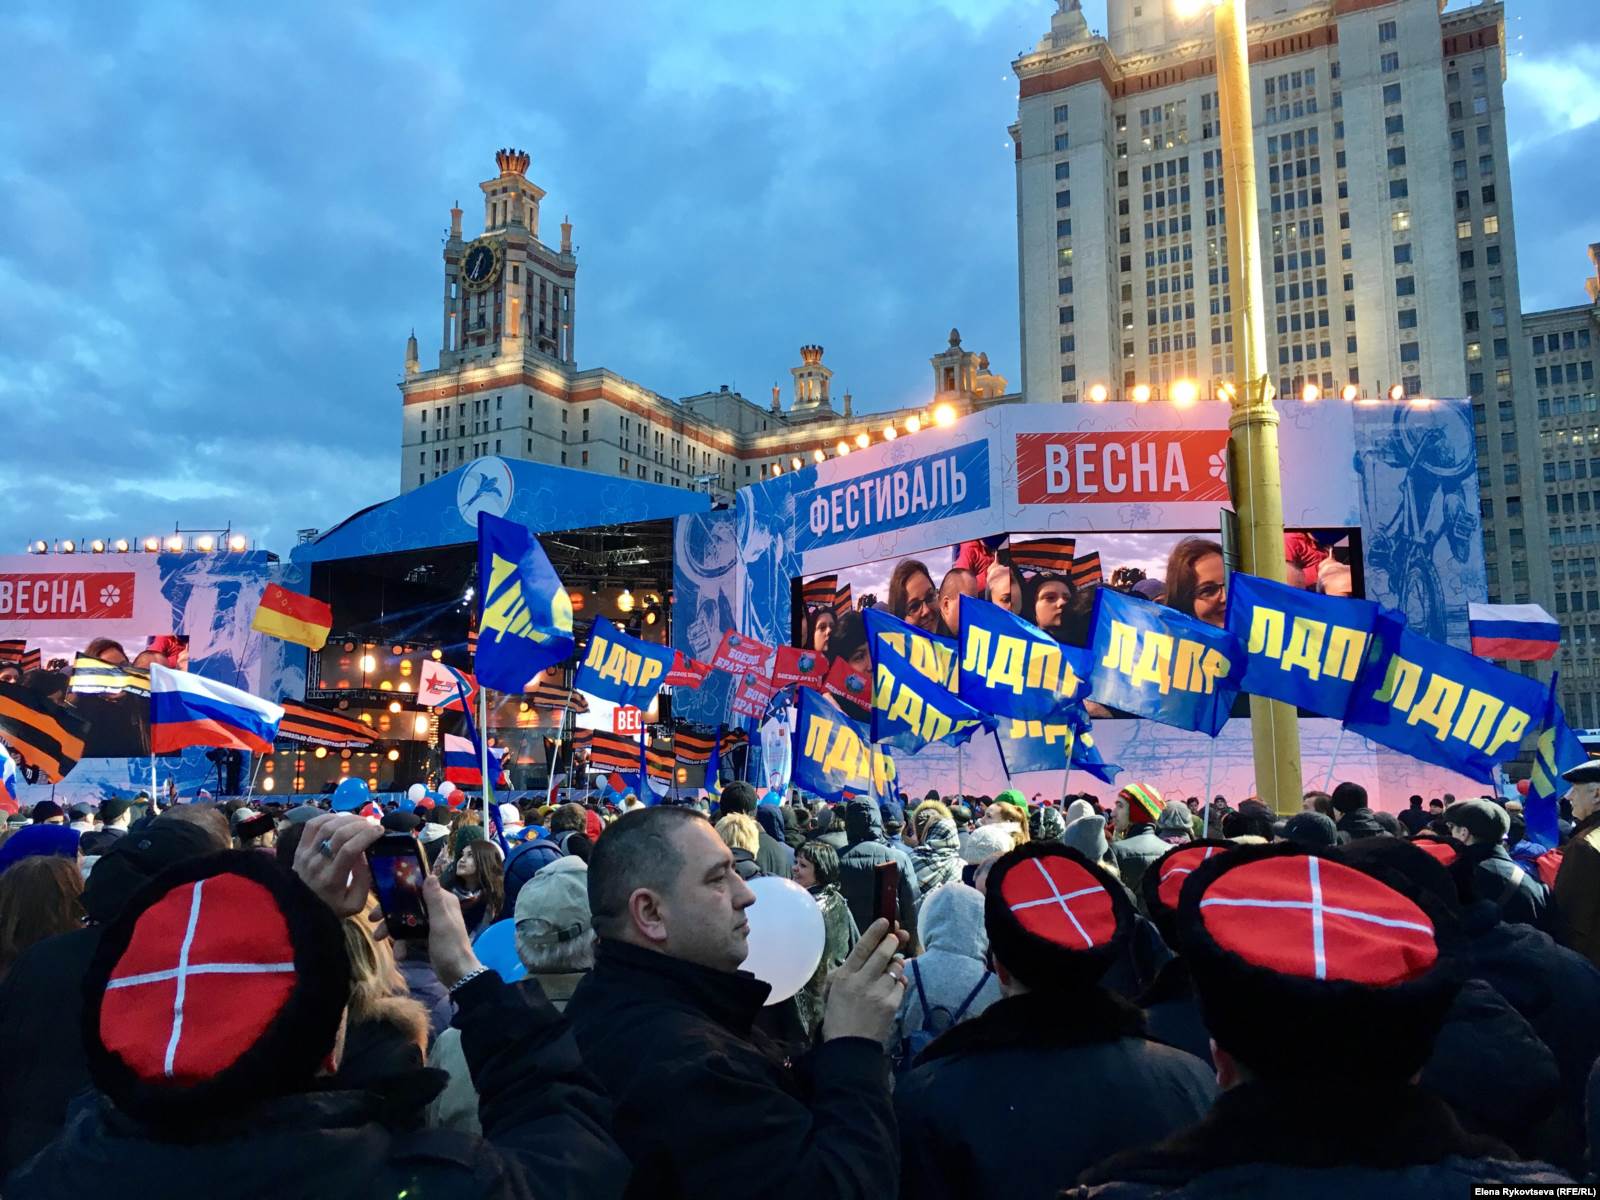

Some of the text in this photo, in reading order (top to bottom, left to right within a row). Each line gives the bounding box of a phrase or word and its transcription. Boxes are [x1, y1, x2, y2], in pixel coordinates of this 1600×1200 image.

[808, 455, 967, 538] ФЕСТИВАЛЬ
[1045, 441, 1190, 495] ВЕСНА
[0, 579, 88, 614] ВЕСНА
[584, 635, 663, 687] ЛДПР
[1102, 619, 1232, 696] ЛДПР
[1247, 604, 1368, 682] ЛДП
[1372, 652, 1531, 757] ЛДПР
